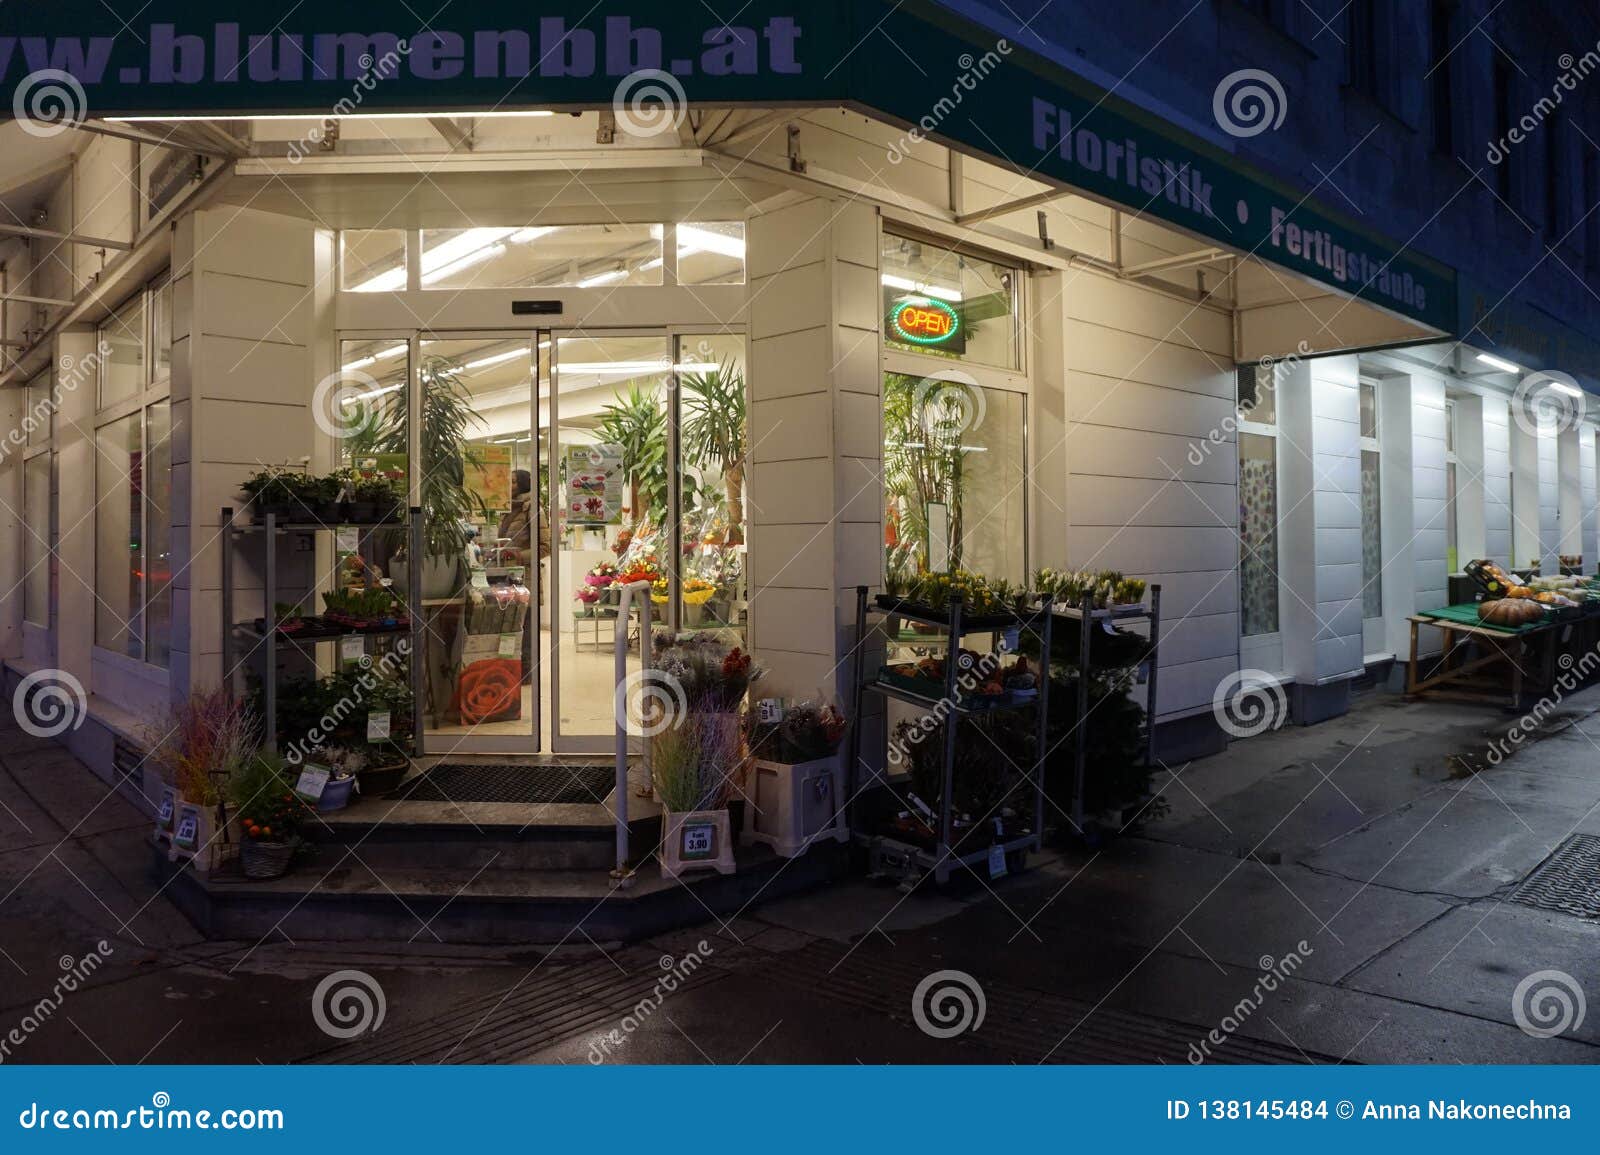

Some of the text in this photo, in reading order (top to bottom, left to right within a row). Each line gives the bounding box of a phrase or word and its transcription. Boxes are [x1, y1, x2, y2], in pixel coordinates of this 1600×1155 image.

[0, 15, 803, 85] w.blumenbb.at
[1031, 96, 1215, 219] Floristik
[903, 307, 951, 334] OPEN
[689, 839, 707, 851] 3,90
